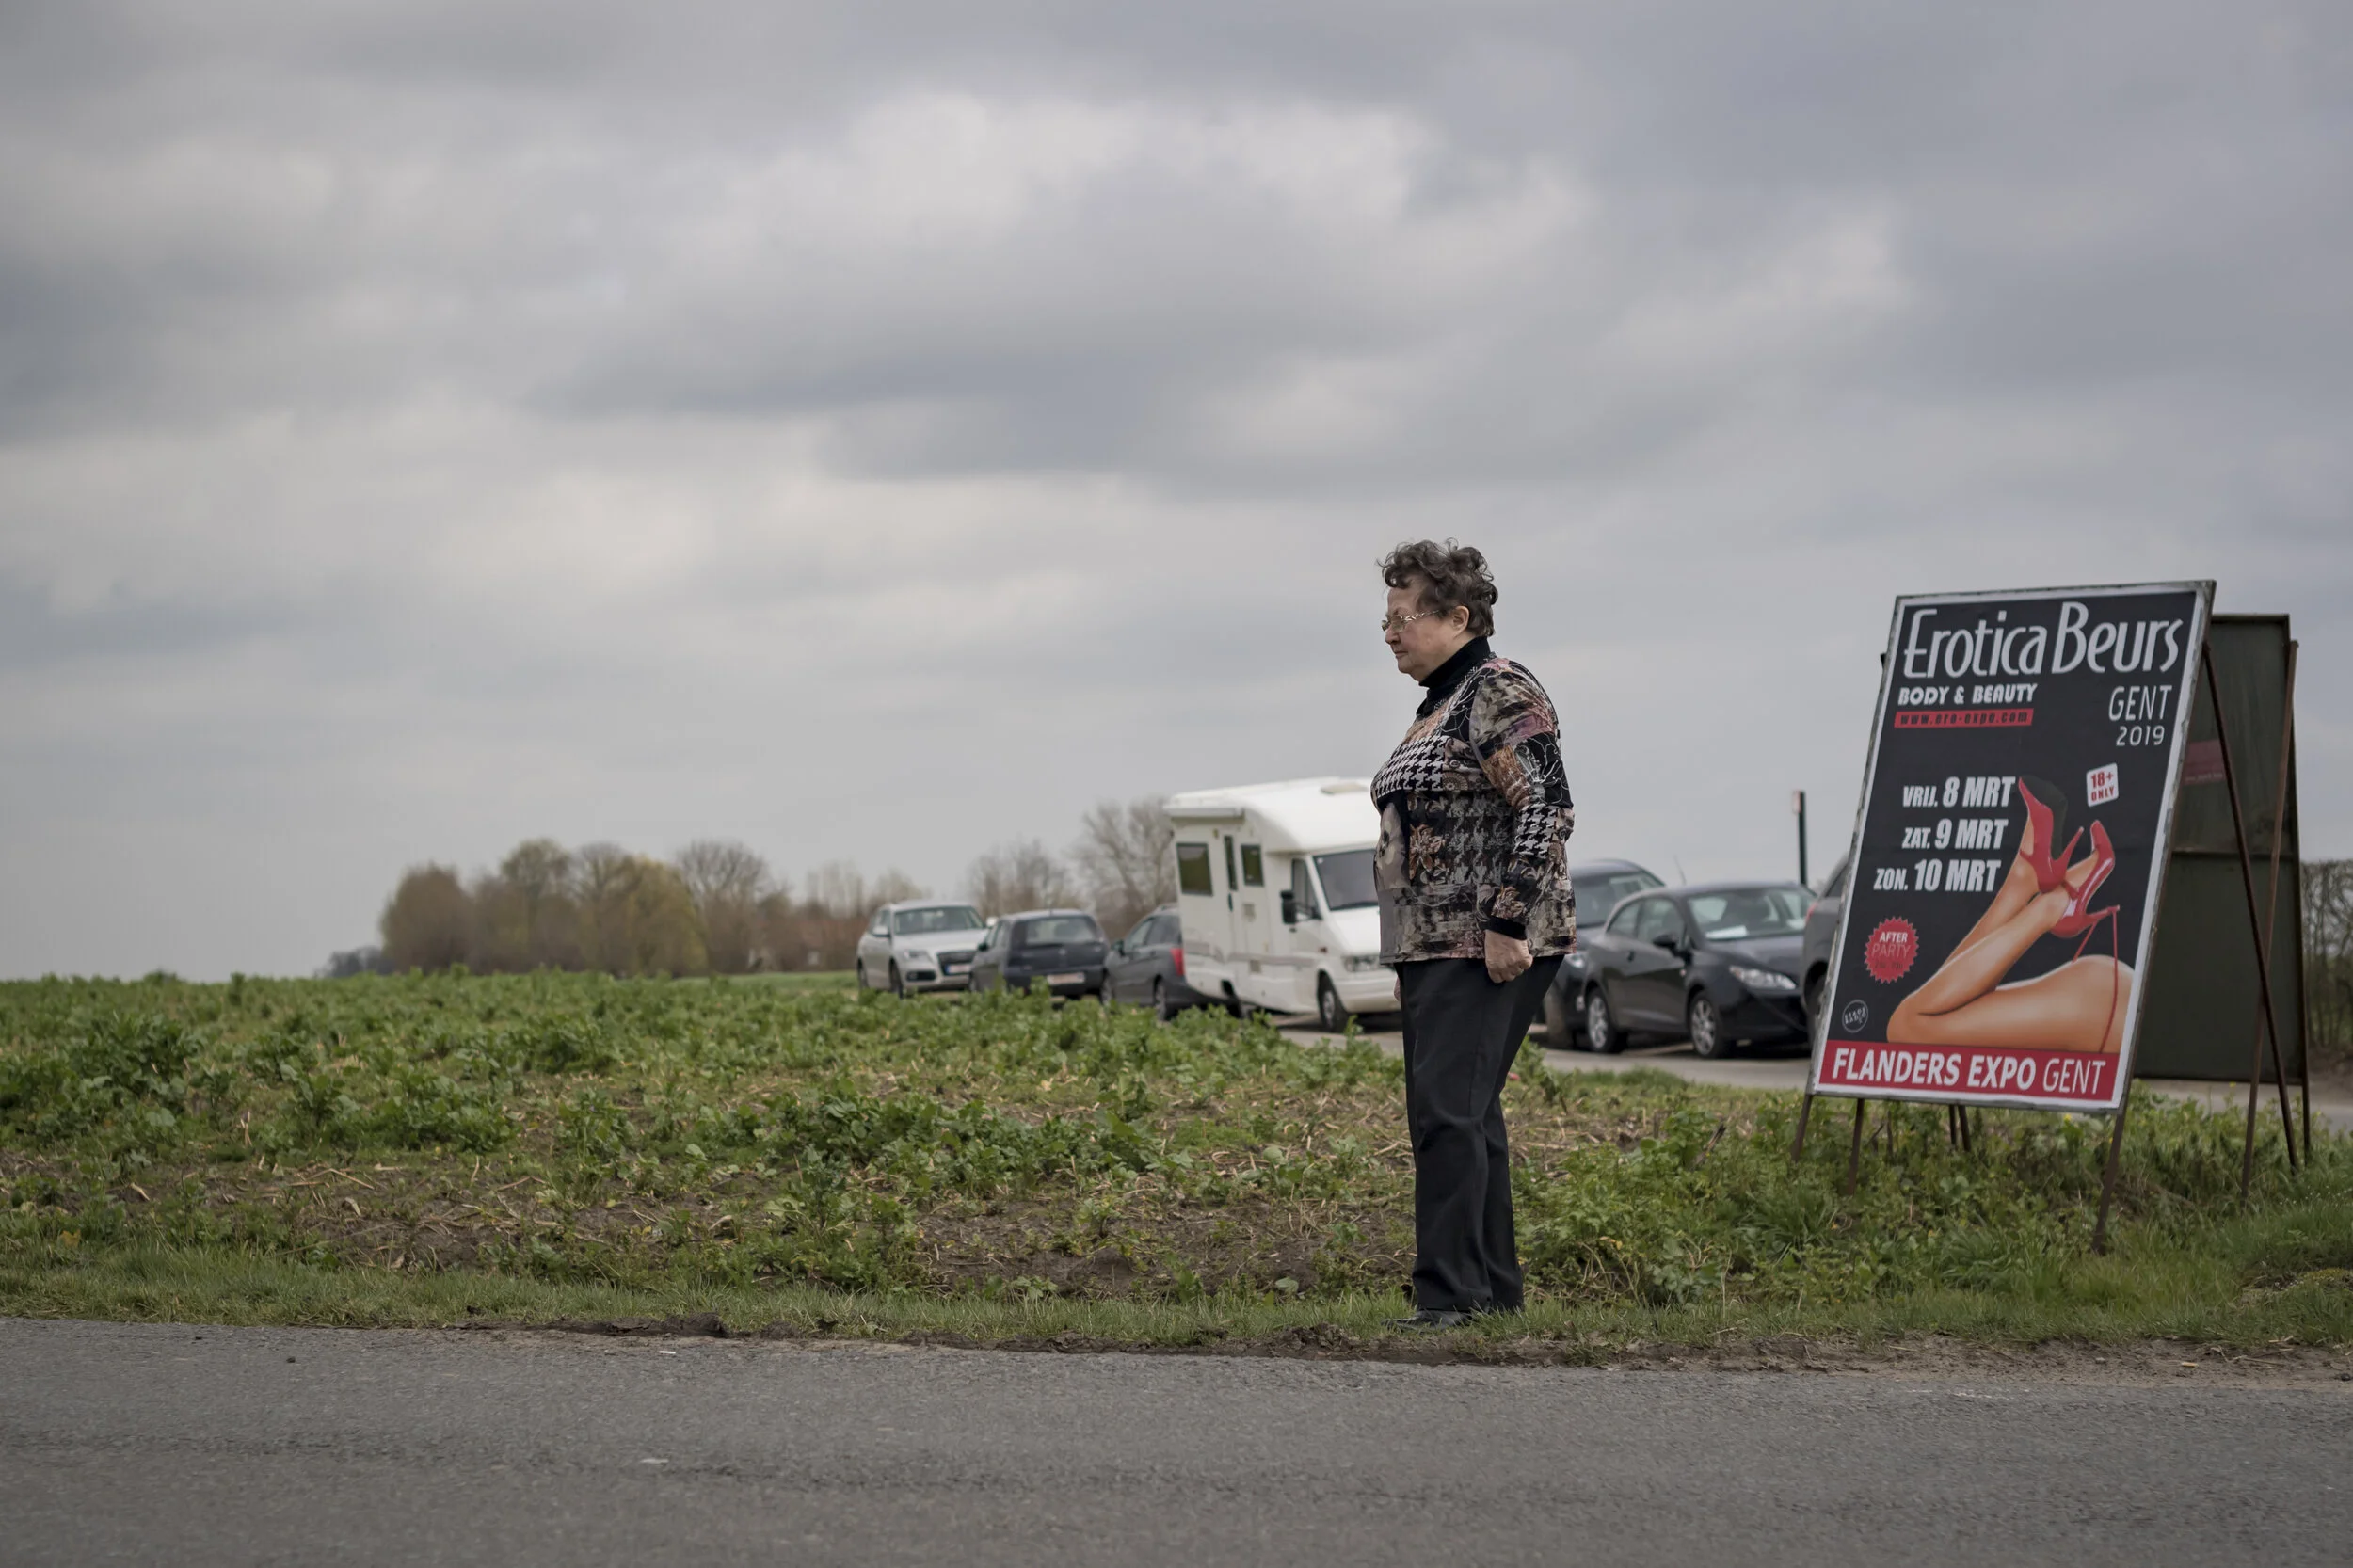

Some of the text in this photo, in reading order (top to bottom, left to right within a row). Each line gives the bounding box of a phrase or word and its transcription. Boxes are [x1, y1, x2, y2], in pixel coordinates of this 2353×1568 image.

[1897, 682, 2038, 706] BODY & BEAUTY
[2108, 684, 2172, 721] GENT
[2116, 725, 2165, 746] 2019
[1902, 776, 2016, 808] VRIJ. 8 MRT
[2091, 771, 2114, 789] 18+
[2091, 786, 2114, 802] ONLY
[1901, 818, 2009, 850] ZAT. 9 MRT
[1873, 858, 2002, 892] ZON. 10 MRT
[1879, 931, 1909, 943] AFTER
[1871, 942, 1912, 959] PARTY
[1832, 1047, 2106, 1095] FLANDERS EXPO GENT
